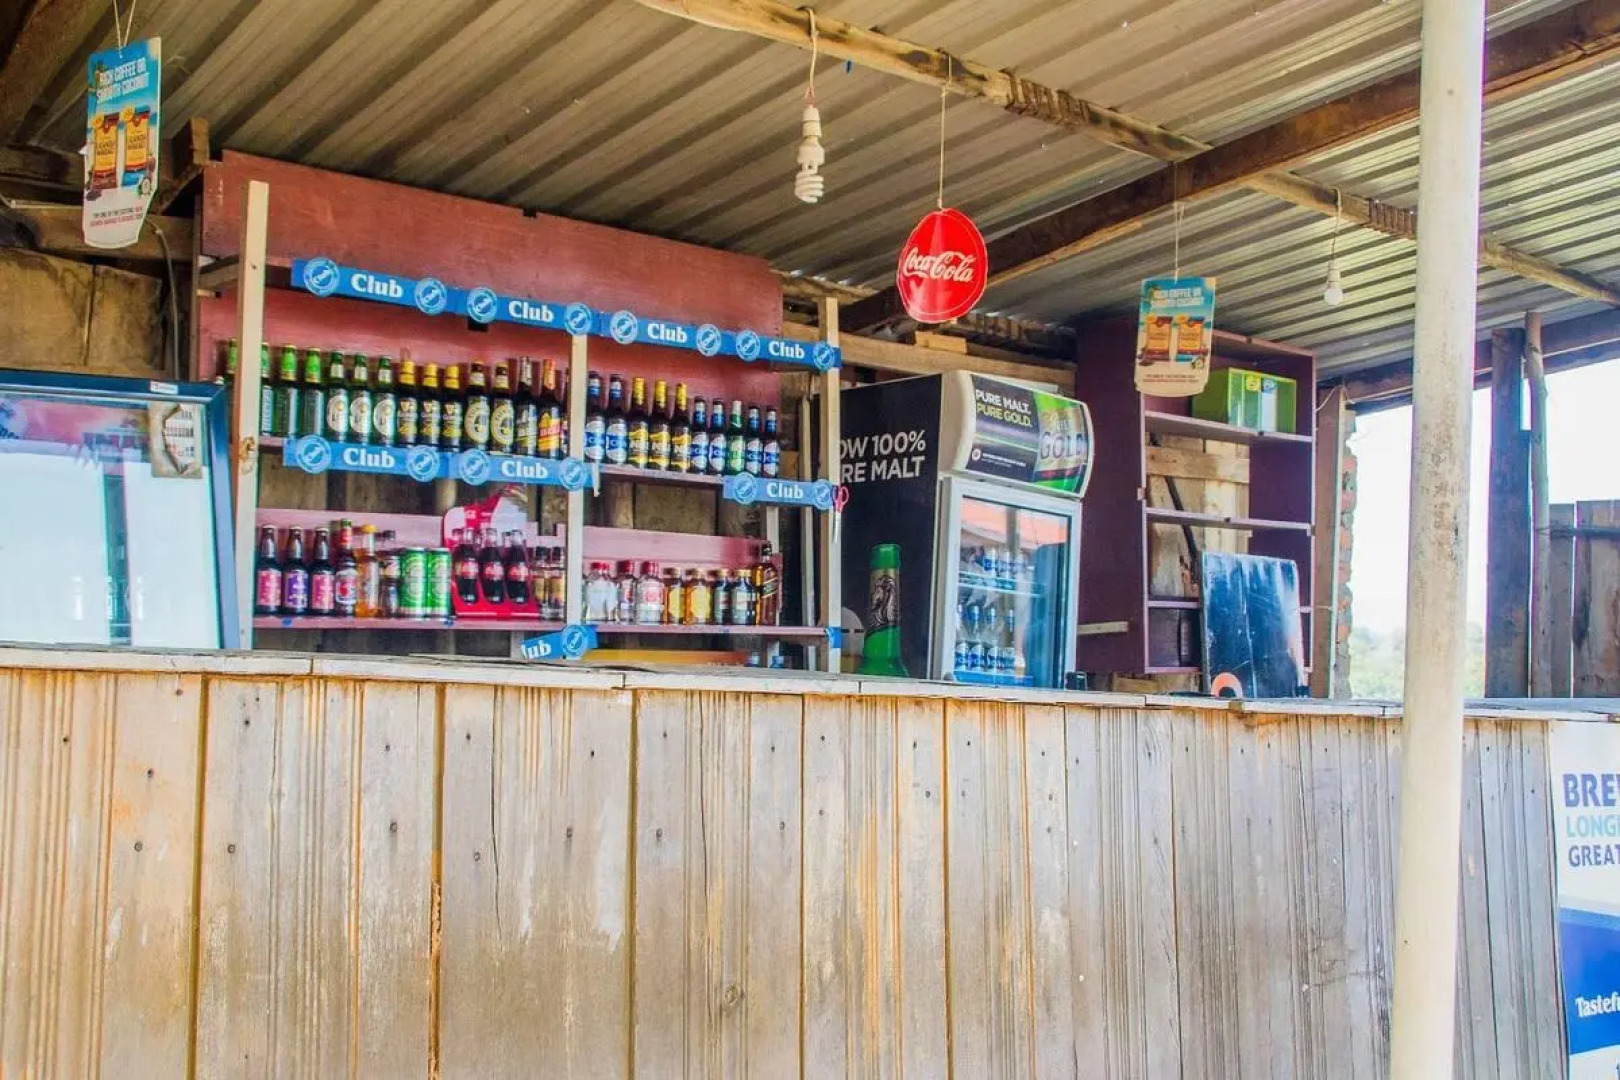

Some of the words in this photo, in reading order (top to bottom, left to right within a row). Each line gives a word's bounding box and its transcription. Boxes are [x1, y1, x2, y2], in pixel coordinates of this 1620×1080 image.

[903, 247, 976, 281] Coca-Cola
[351, 274, 403, 298] Club
[508, 300, 555, 322] Club
[647, 323, 688, 343] Club
[768, 341, 806, 360] Club
[975, 389, 1002, 406] PURE
[1002, 396, 1032, 415] MALT.
[976, 402, 1003, 420] PURE
[1004, 410, 1034, 428] GOLD.
[871, 430, 926, 456] 100%
[343, 447, 396, 469] Club
[501, 460, 549, 479] Club
[871, 455, 926, 481] MALT
[766, 482, 804, 499] Club
[1562, 773, 1620, 808] BRE
[1566, 813, 1620, 838] LONG
